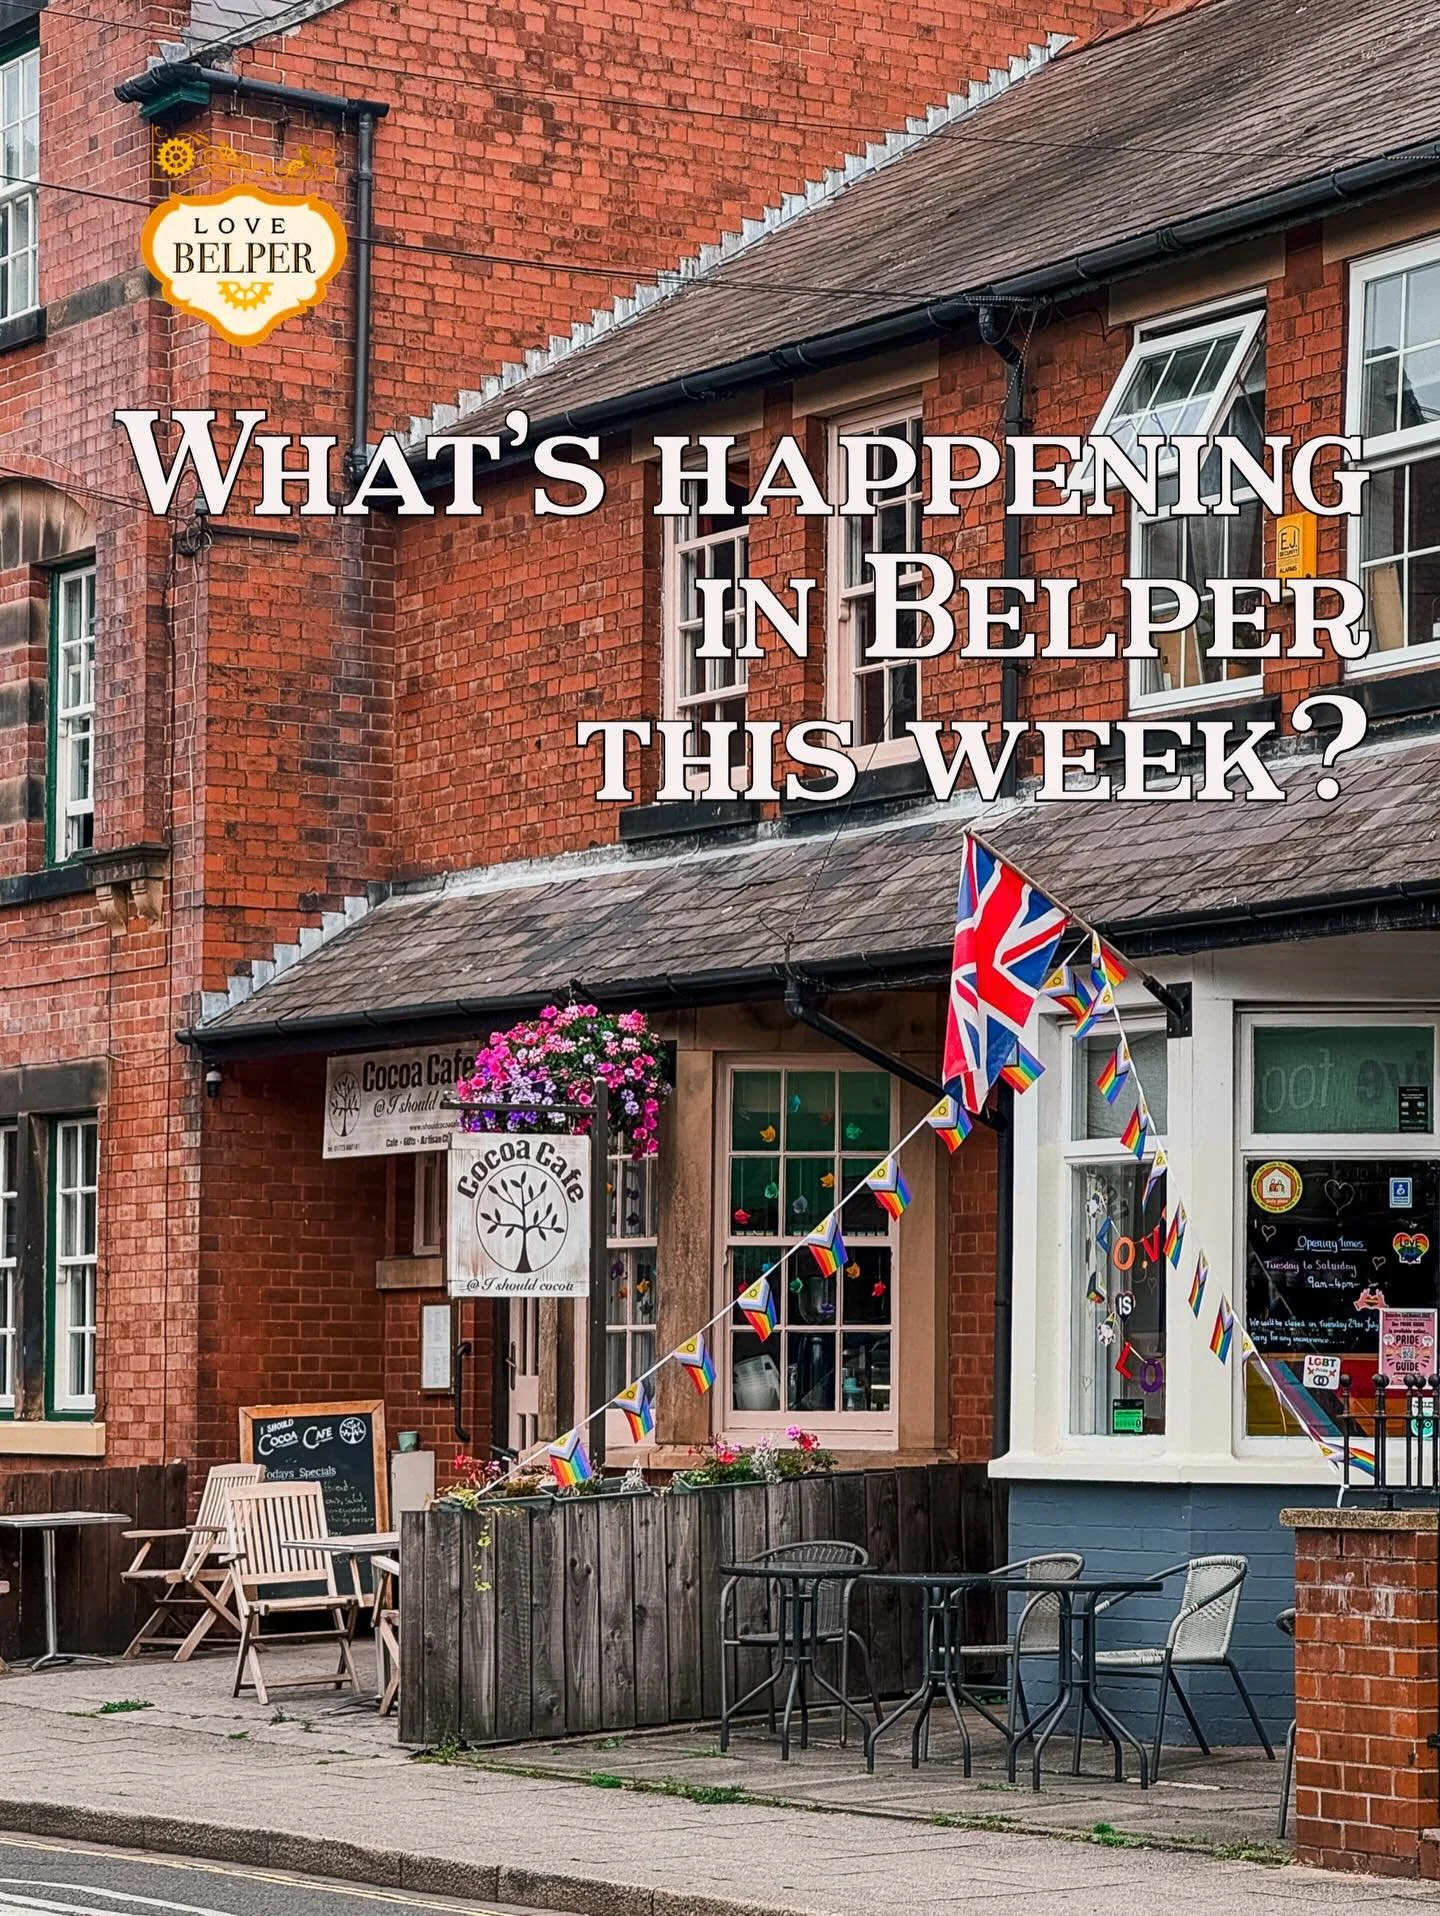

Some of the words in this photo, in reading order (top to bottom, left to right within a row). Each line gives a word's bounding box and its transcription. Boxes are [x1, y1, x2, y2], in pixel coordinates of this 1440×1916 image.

[362, 1060, 423, 1092] Cocoa
[426, 1048, 475, 1086] Cafe
[398, 1090, 439, 1114] should
[457, 1139, 531, 1199] Cocoa
[535, 1141, 584, 1203] Cafe
[1096, 1210, 1164, 1271] LOV
[1297, 1235, 1338, 1253] Opening
[1338, 1235, 1365, 1249] Times
[1264, 1260, 1300, 1274] Tuesday
[1303, 1260, 1313, 1270] to
[1316, 1259, 1357, 1278] Saturday
[495, 1278, 539, 1291] should
[539, 1282, 575, 1291] cocoa
[1119, 1296, 1132, 1314] IS
[1284, 1319, 1305, 1327] closed
[1318, 1319, 1347, 1331] Tuesday
[1396, 1335, 1420, 1345] PRIDE
[1308, 1356, 1337, 1367] LGBT
[1395, 1362, 1420, 1372] GUIDE
[260, 1426, 264, 1435] I
[266, 1418, 294, 1433] SHOULD
[258, 1430, 299, 1456] COCOA
[302, 1425, 333, 1449] CAFE
[264, 1468, 295, 1480] odays
[299, 1465, 337, 1479] Specials
